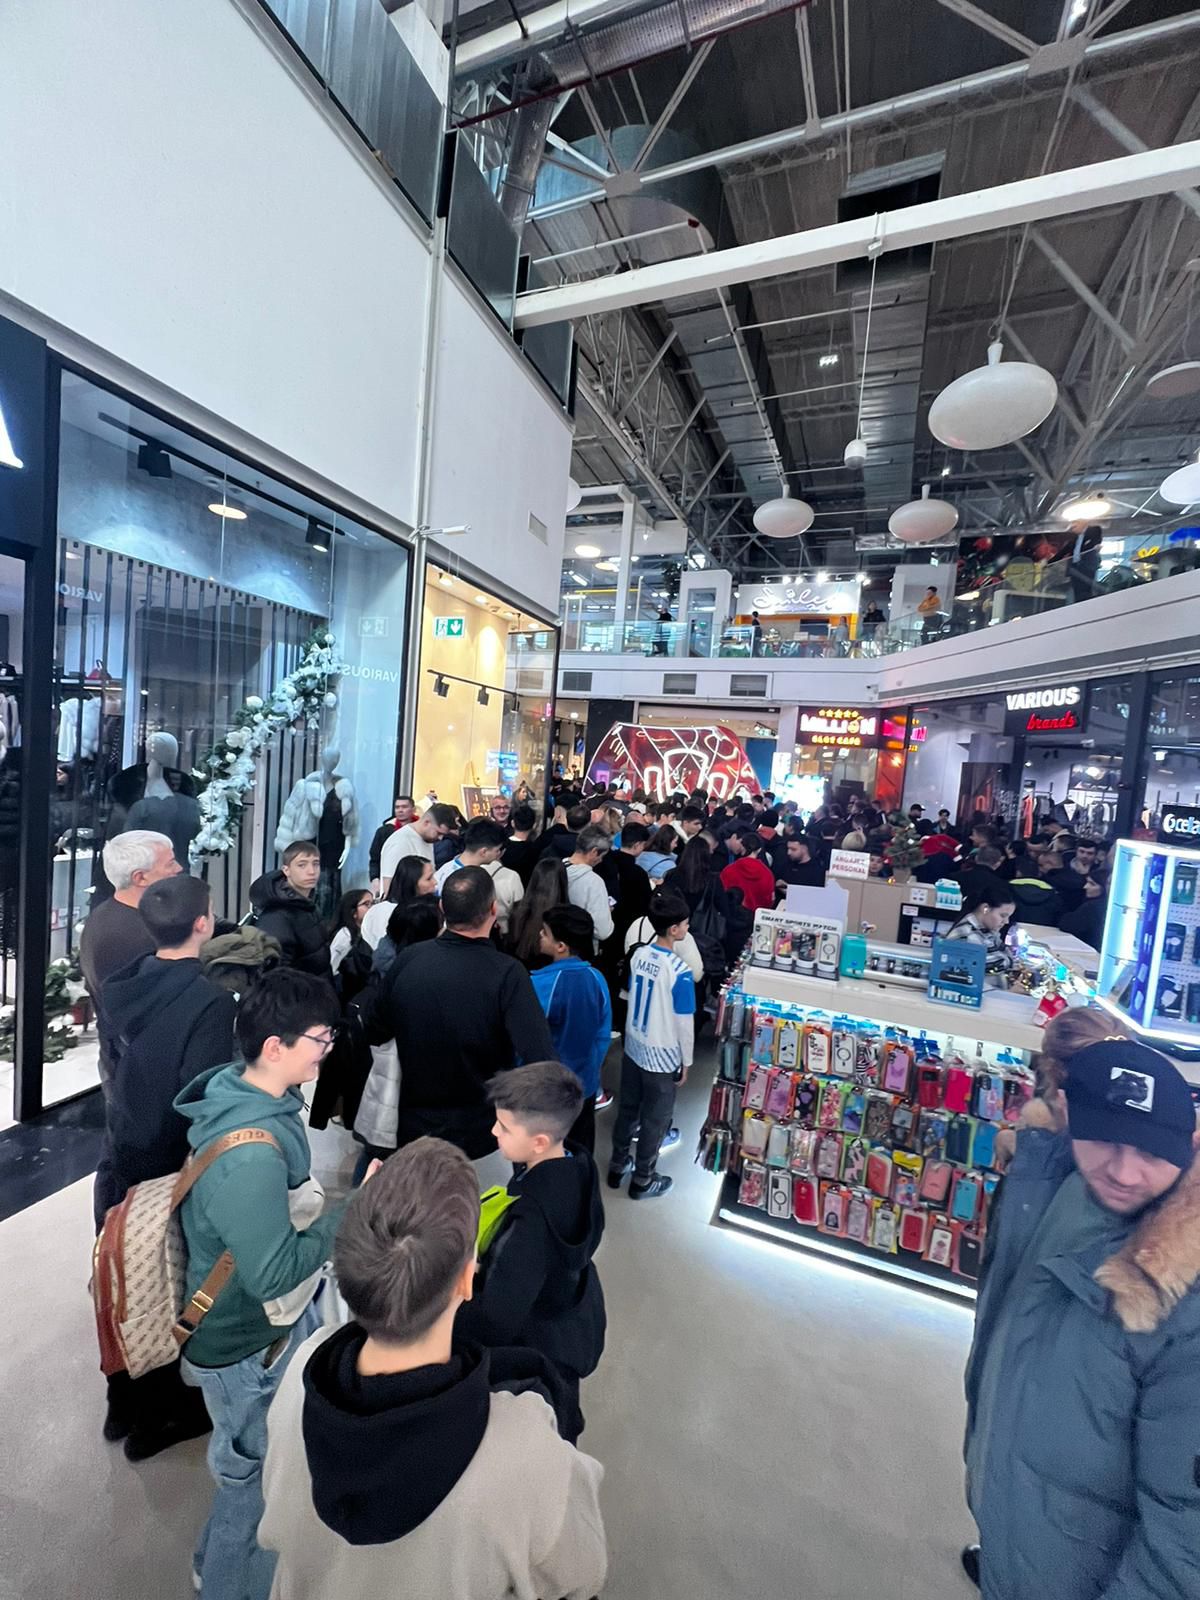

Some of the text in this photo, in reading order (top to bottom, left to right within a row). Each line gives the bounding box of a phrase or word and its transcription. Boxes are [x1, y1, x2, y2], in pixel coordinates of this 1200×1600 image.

[1006, 687, 1080, 711] VARIOUS
[1027, 710, 1077, 731] brands
[631, 974, 655, 1037] 11
